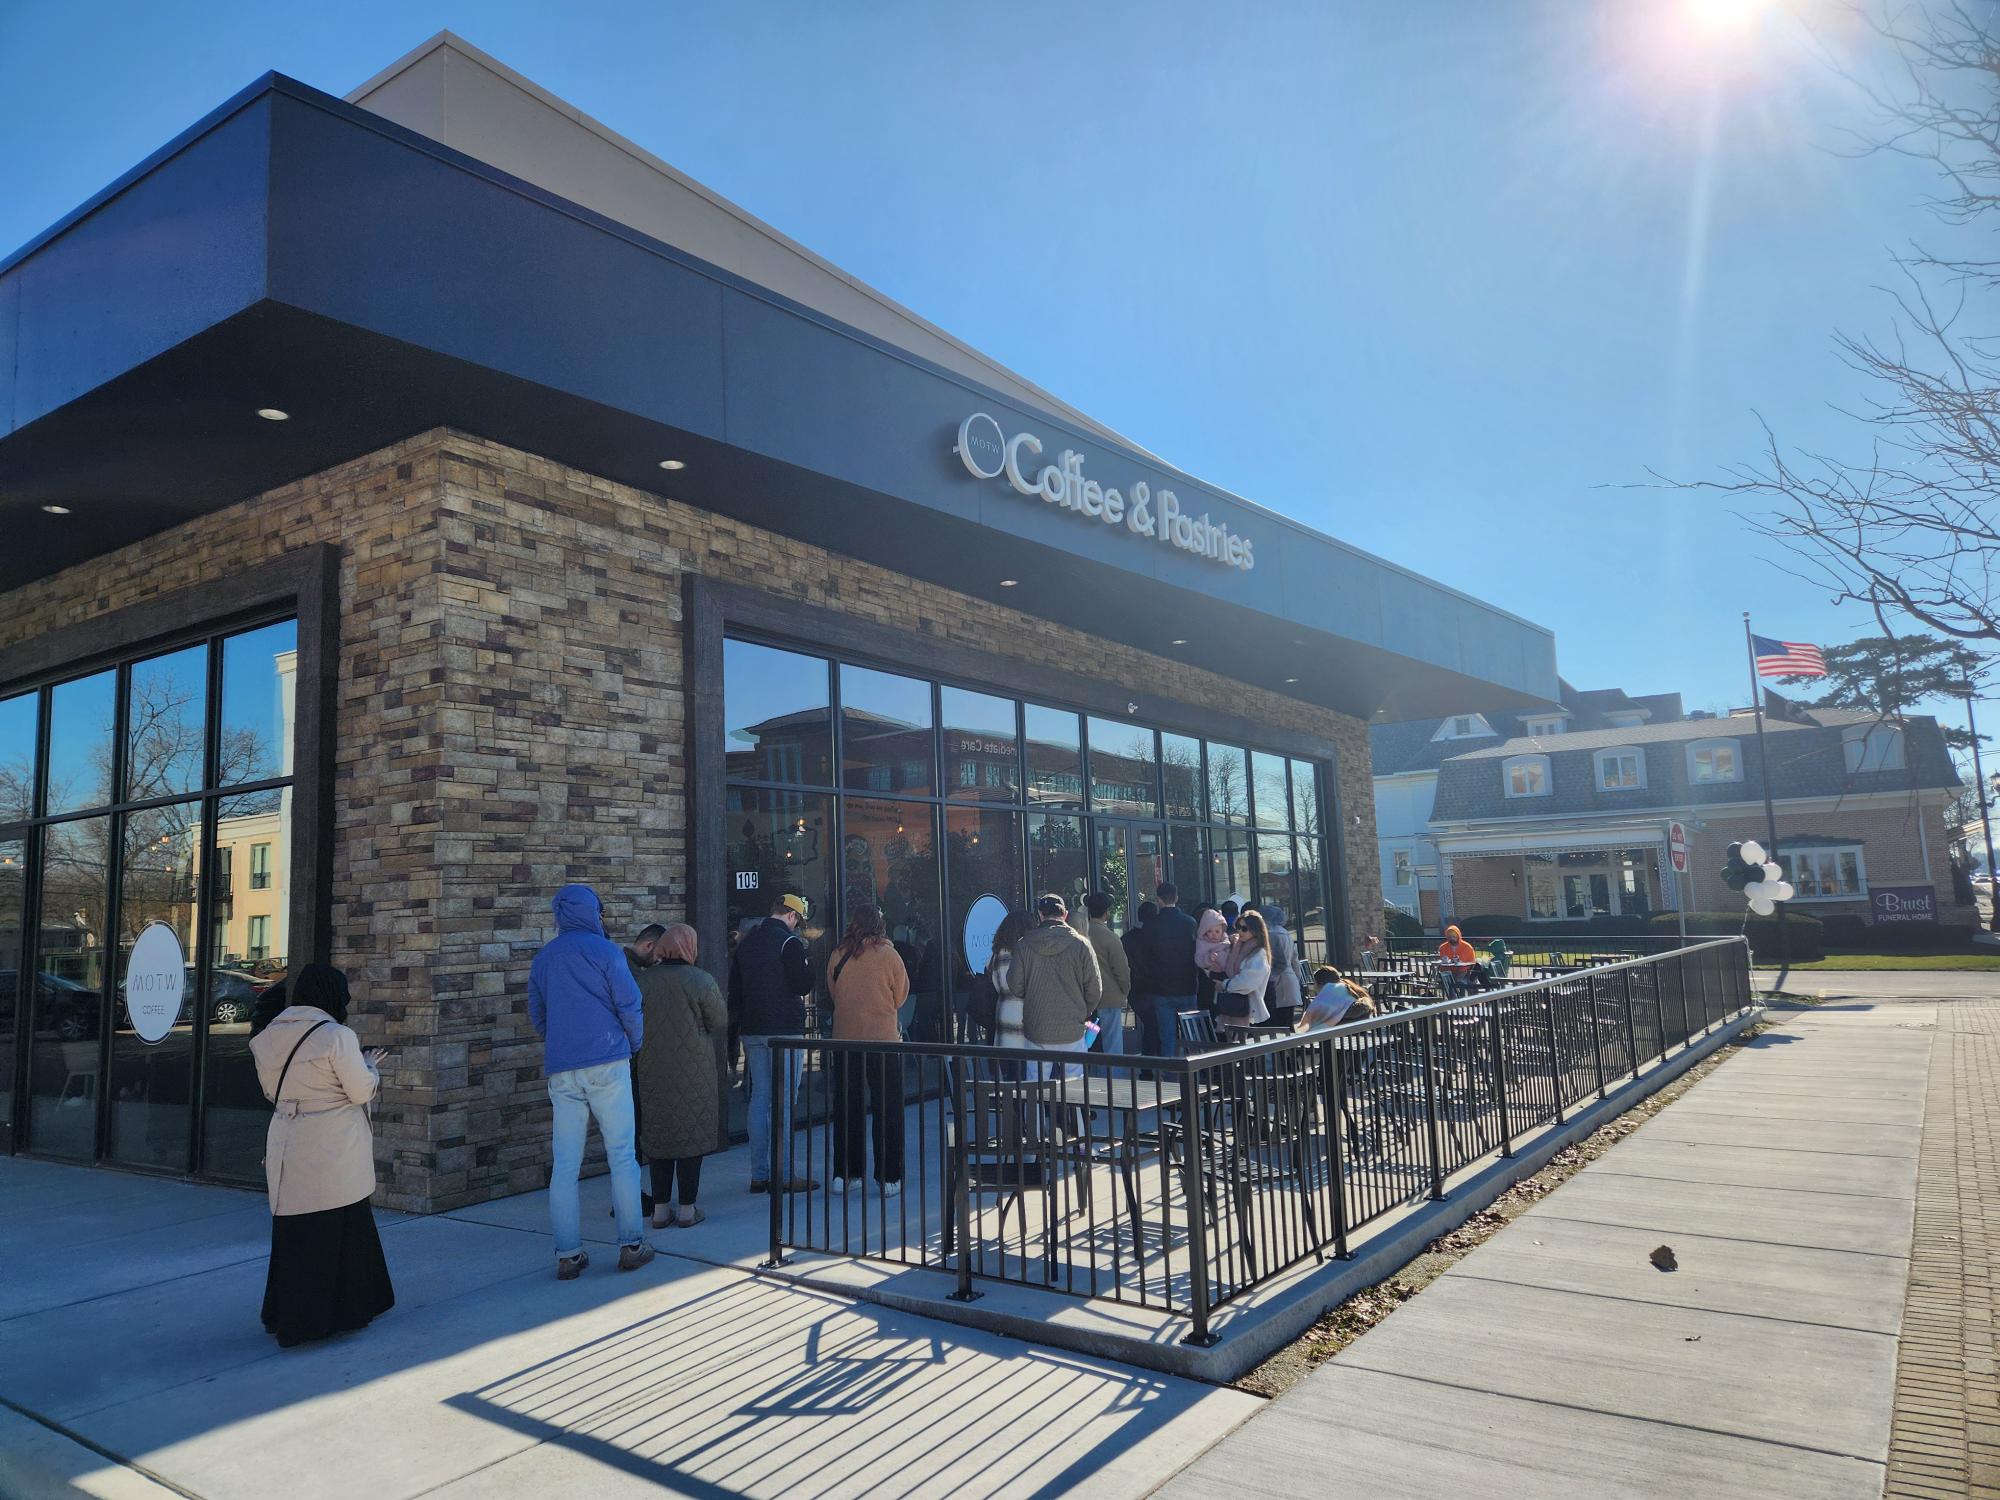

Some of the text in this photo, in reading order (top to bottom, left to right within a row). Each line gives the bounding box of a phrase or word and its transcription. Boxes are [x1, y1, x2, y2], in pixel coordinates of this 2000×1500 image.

[970, 435, 1000, 455] MOTW
[1005, 432, 1255, 571] Coffee & Pastries
[738, 872, 757, 889] 109
[1875, 892, 1932, 911] Brust
[1878, 913, 1911, 921] FUNERAL
[132, 973, 177, 991] MOTW
[142, 1004, 166, 1015] COFFEE
